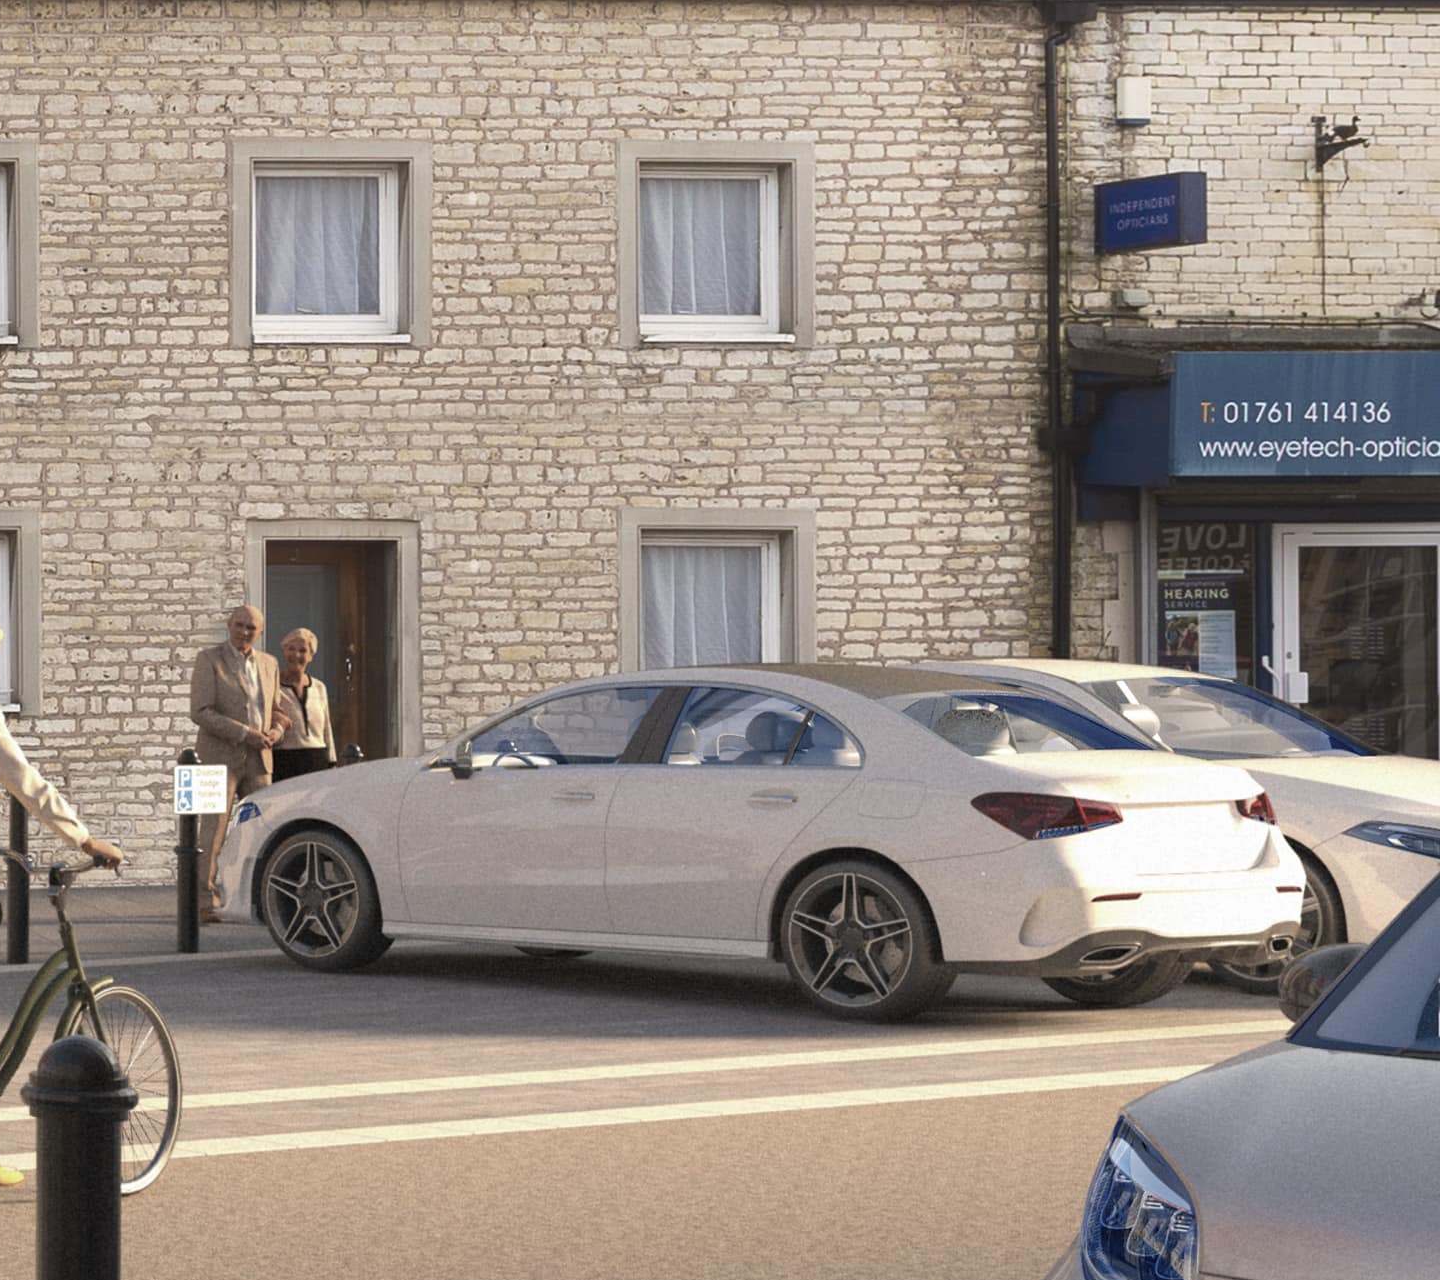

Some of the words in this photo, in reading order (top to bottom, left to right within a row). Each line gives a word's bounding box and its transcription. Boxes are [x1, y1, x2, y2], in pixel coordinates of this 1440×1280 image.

[1109, 195, 1176, 214] INDEPENDENT
[1116, 214, 1169, 231] OPTICIANS
[1200, 402, 1216, 423] T:
[1223, 401, 1293, 423] 01761
[1304, 401, 1392, 423] 414136
[1163, 588, 1230, 600] HEARING
[1164, 600, 1208, 609] SERVICE
